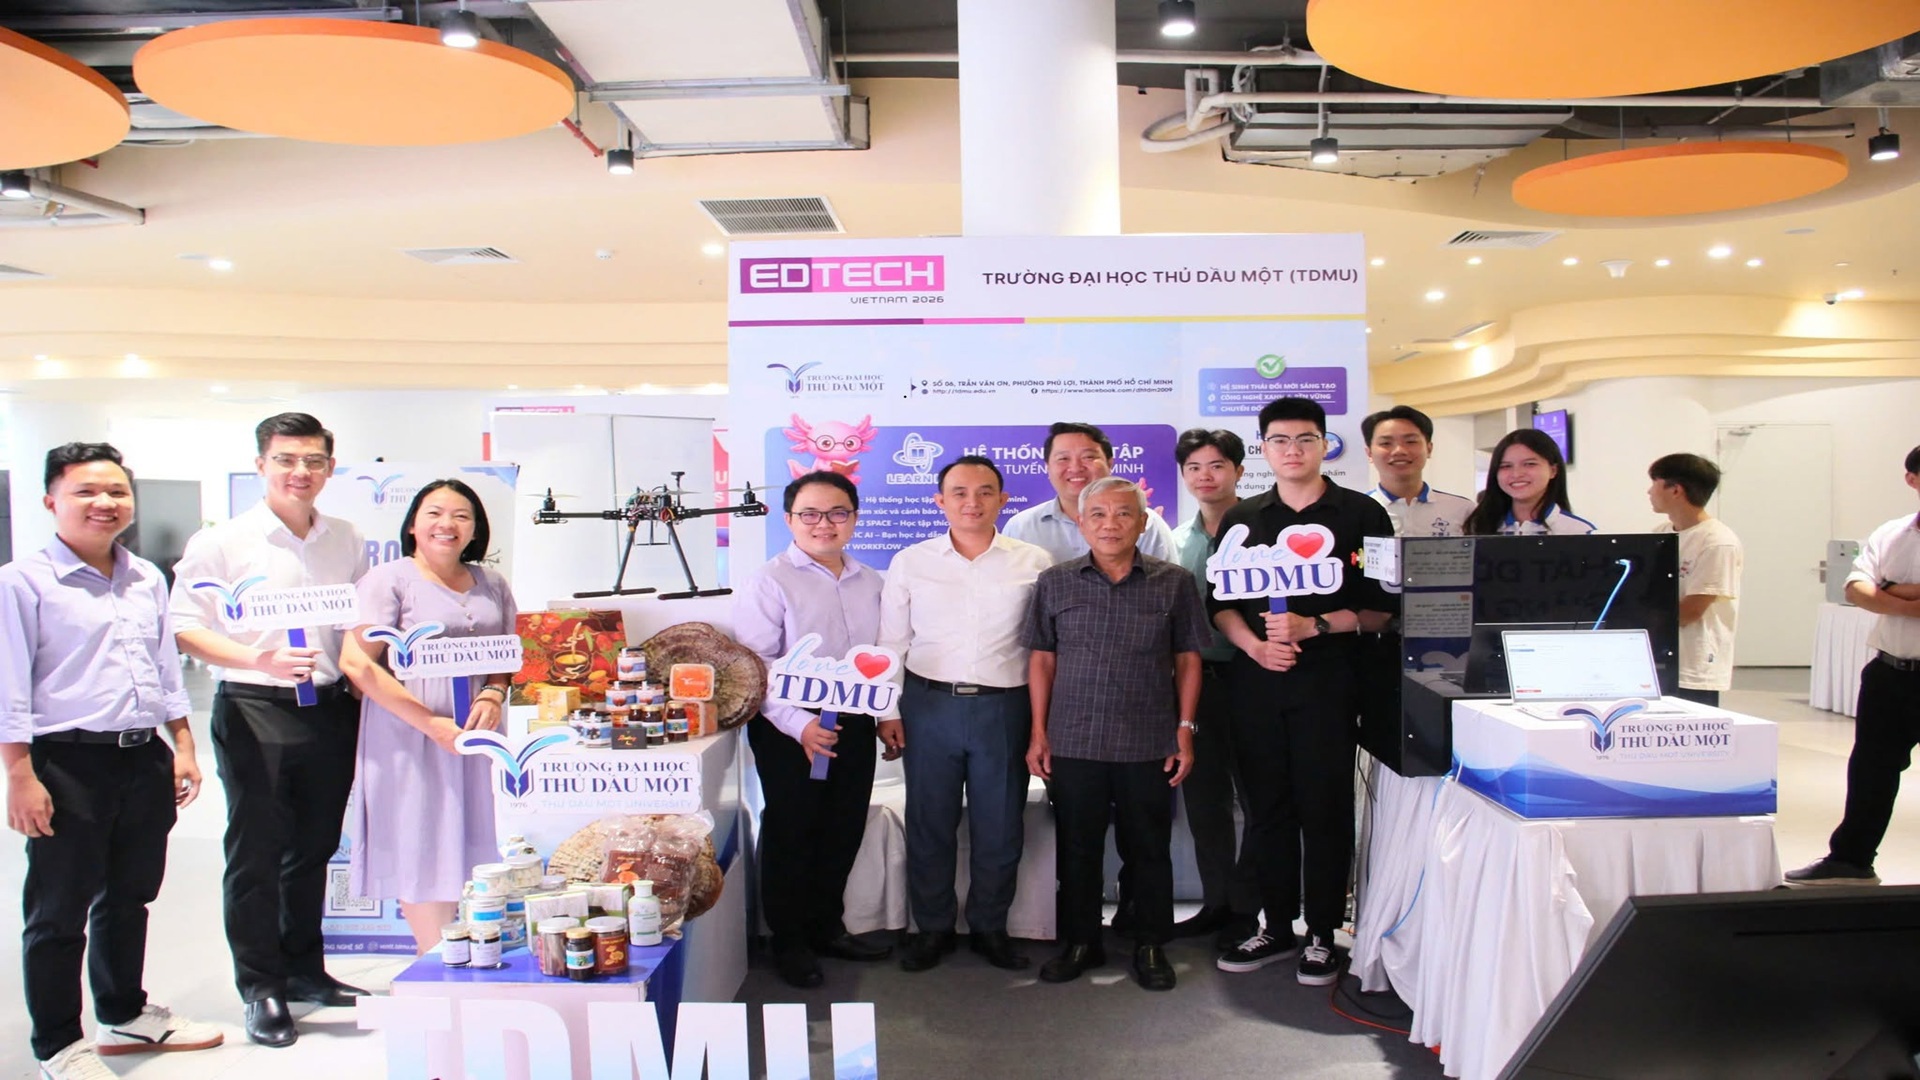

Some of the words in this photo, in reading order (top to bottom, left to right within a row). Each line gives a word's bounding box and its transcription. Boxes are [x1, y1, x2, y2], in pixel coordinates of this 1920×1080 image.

[750, 261, 934, 288] EDTECH
[982, 268, 1064, 284] TRƯỜNG
[1068, 271, 1101, 287] ĐẠI
[1106, 271, 1147, 286] HỌC
[1153, 267, 1191, 283] THỦ
[1196, 266, 1236, 282] DẦU
[1241, 266, 1283, 285] MỘT
[1290, 269, 1358, 283] (TDMU)
[850, 296, 908, 304] VIETNAM
[912, 295, 944, 304] 2026
[992, 443, 1045, 460] THỐN
[1112, 443, 1144, 463] TẬP
[1003, 461, 1048, 475] TUYẾN
[1214, 562, 1337, 595] TDMU
[776, 673, 895, 711] TDMU
[653, 761, 689, 774] HỌC
[644, 773, 693, 796] MỘT
